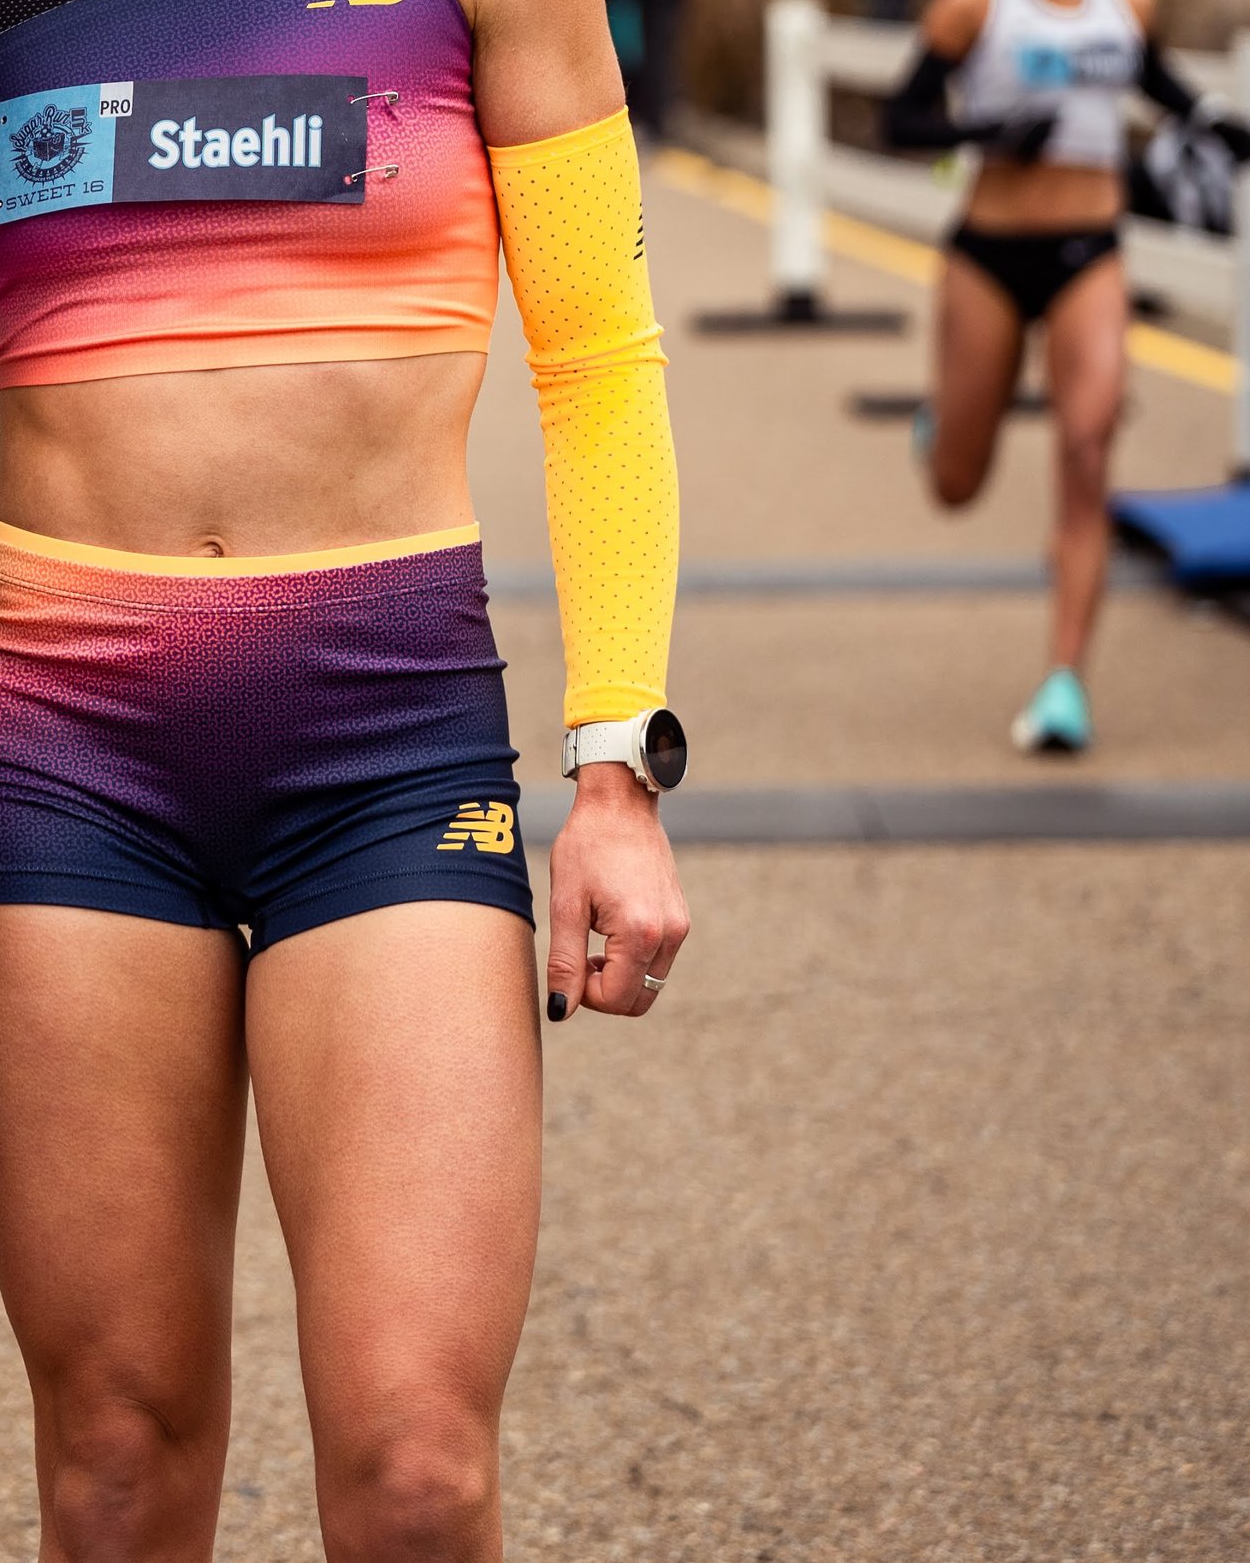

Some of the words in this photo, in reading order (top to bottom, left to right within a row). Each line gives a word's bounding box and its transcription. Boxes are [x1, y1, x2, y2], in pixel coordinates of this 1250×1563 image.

[100, 98, 131, 116] PRO
[10, 114, 44, 149] Sugar
[44, 104, 71, 126] Run
[148, 113, 324, 170] Staehli
[6, 183, 76, 210] SWEET
[82, 180, 104, 194] 16
